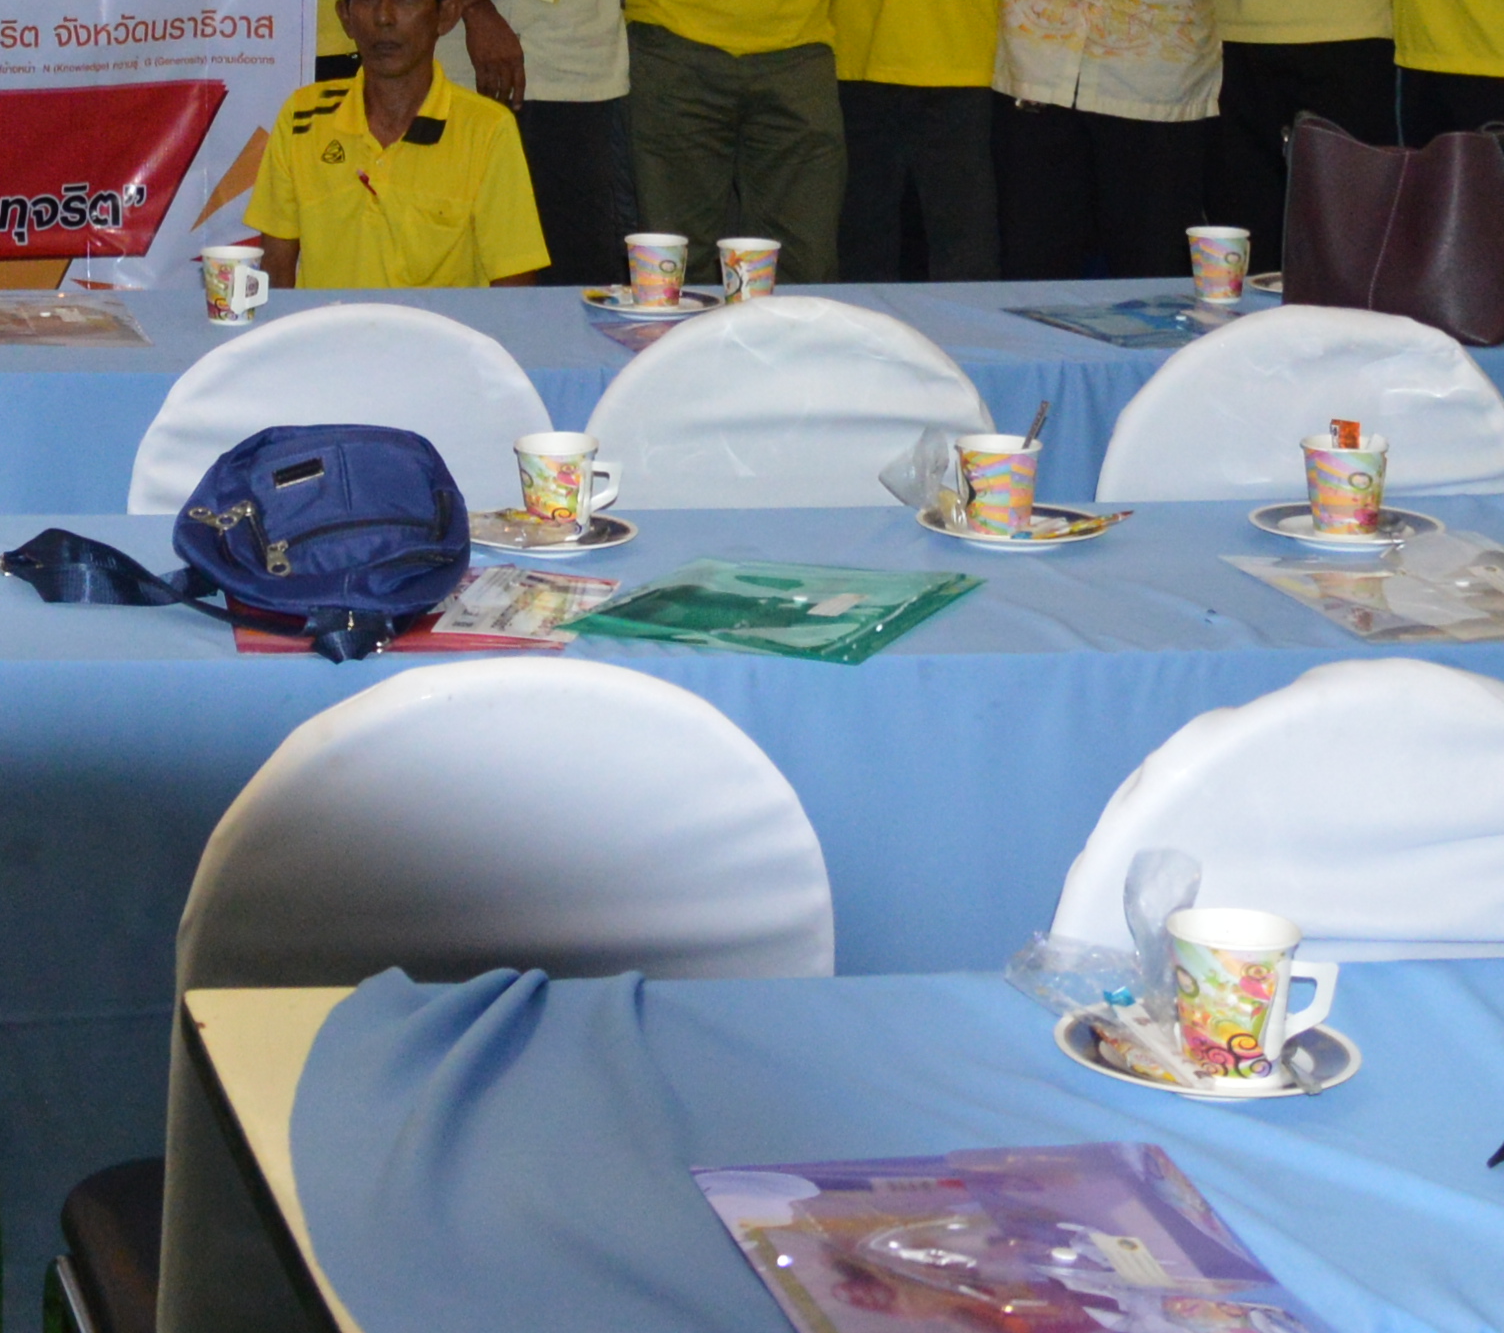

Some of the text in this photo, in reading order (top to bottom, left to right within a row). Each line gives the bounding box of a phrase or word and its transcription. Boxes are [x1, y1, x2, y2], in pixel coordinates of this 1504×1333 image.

[54, 9, 274, 48] จังหวัดนราธิวาส
[43, 64, 51, 73] N
